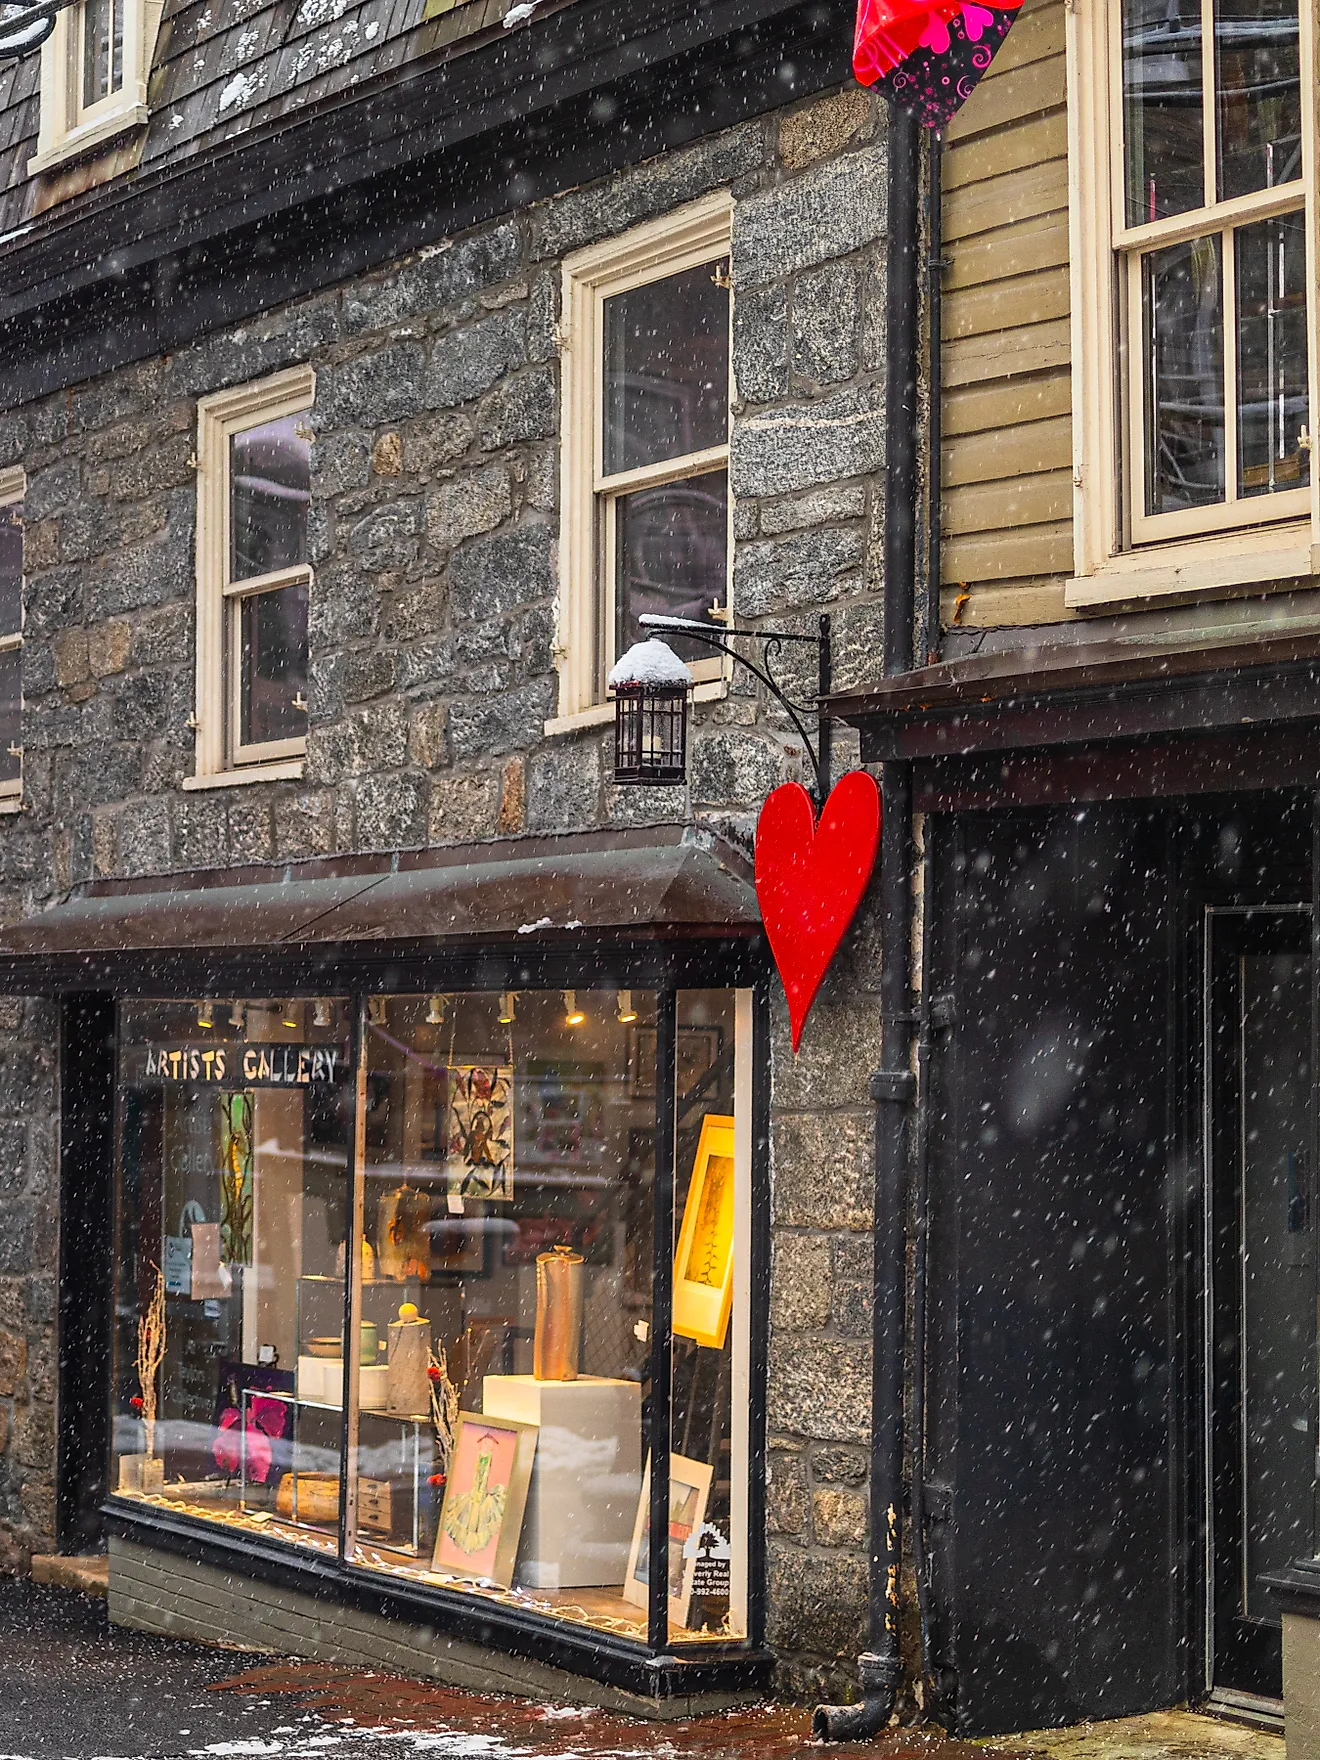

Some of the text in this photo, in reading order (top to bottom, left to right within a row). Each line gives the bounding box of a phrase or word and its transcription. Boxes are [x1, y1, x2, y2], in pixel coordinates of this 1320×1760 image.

[145, 1048, 337, 1083] ARTISTS GALLERY
[696, 1561, 726, 1569] naged by
[706, 1578, 730, 1588] Group
